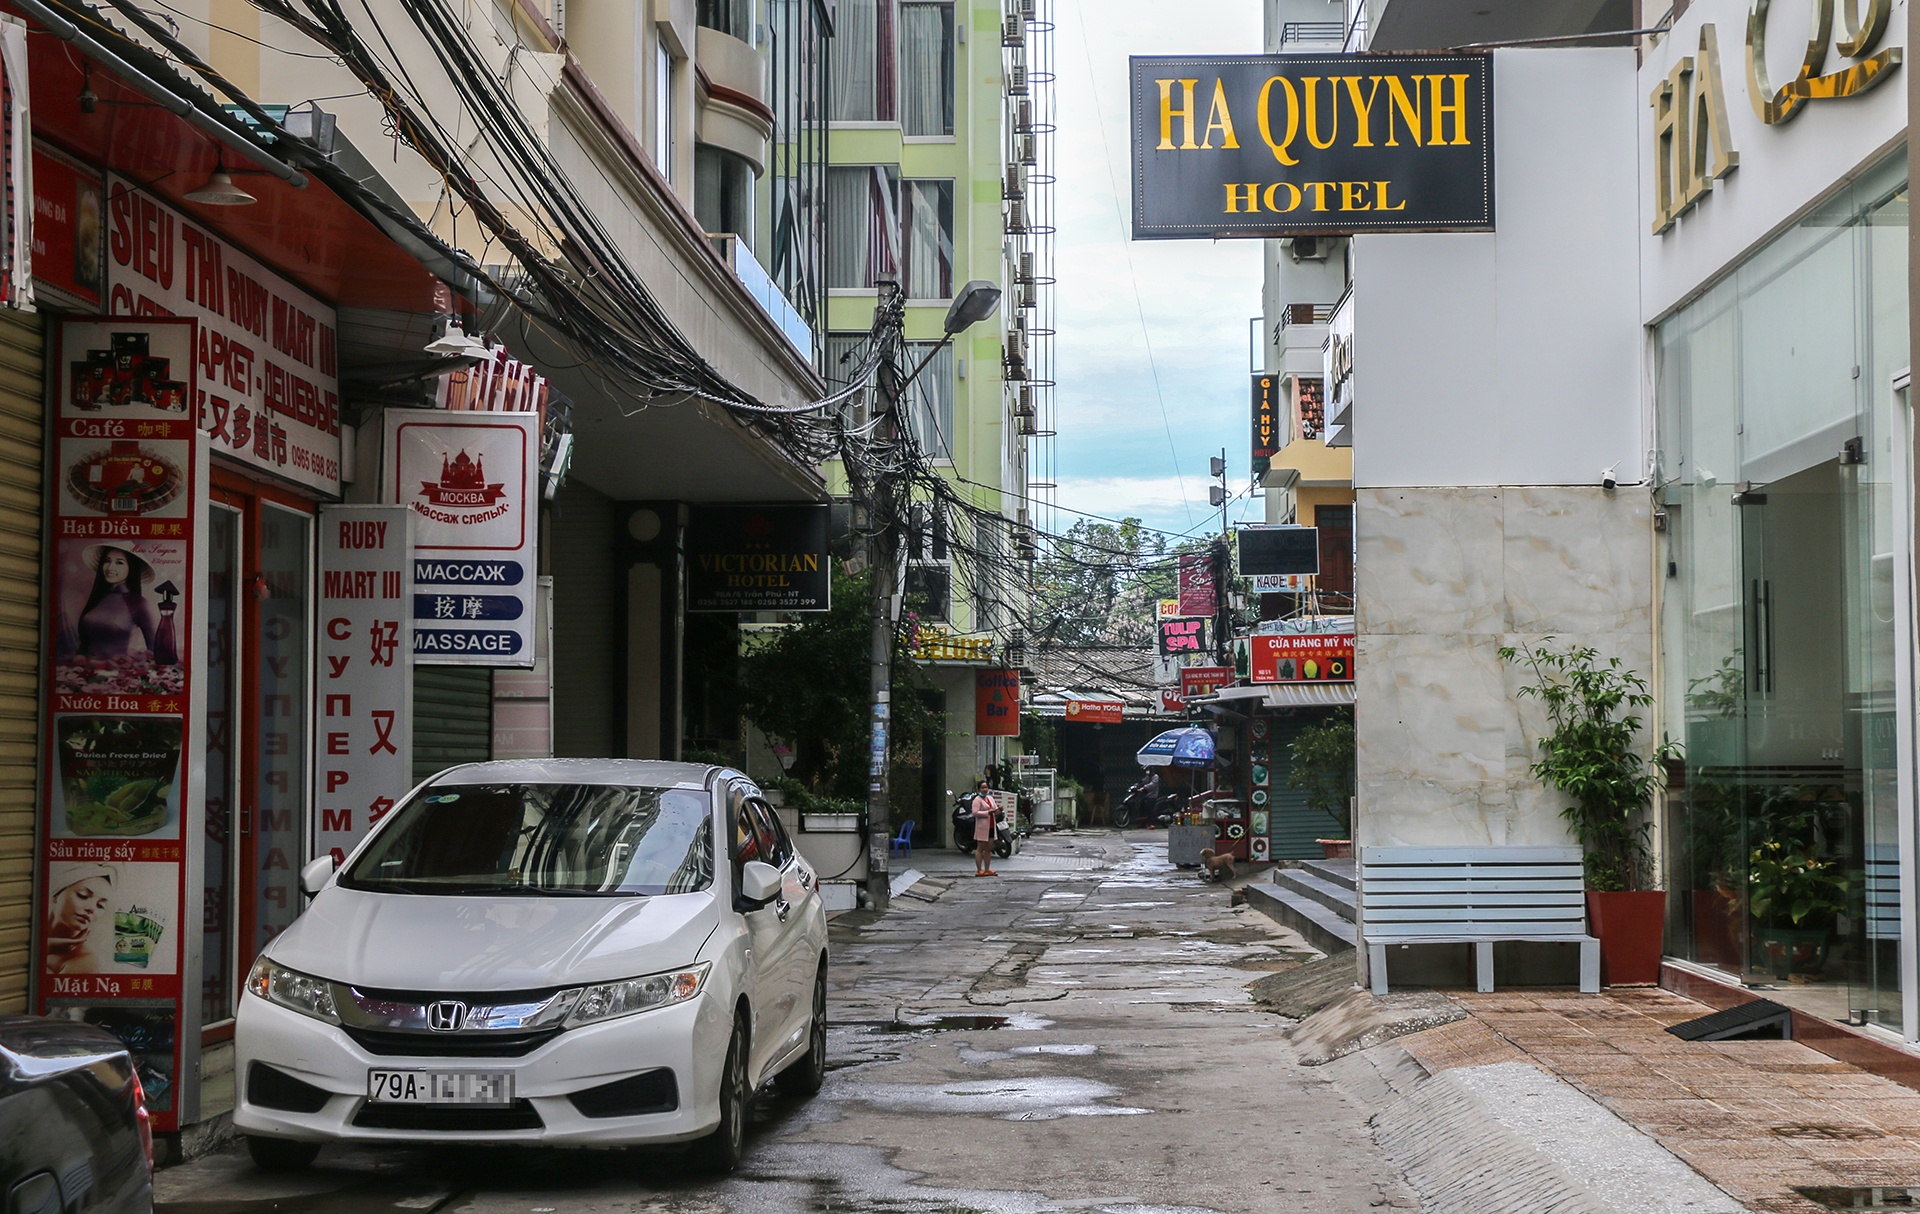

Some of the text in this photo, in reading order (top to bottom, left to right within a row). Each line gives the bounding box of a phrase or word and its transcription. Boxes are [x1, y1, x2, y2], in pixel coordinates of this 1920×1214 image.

[1156, 73, 1471, 167] HA QUYNH
[1652, 23, 1739, 236] HA
[1223, 180, 1406, 214] HOTEL
[227, 265, 269, 343] RUBY
[272, 294, 316, 369] MART
[320, 322, 336, 379] III
[264, 359, 339, 438] ДЕШЕВЫЕ
[1259, 378, 1272, 411] GIA
[70, 418, 171, 438] Café 咖啡
[1259, 414, 1271, 446] HUY
[292, 444, 337, 482] 0965 698 825
[440, 491, 486, 503] МОСКВА
[462, 503, 508, 525] слепых
[62, 520, 94, 538] Hạt
[100, 518, 141, 535] Điều
[339, 520, 387, 550] RUBY
[416, 564, 506, 582] МАССАЖ
[698, 553, 819, 573] VICTORIAN
[324, 570, 377, 599] MART
[382, 570, 400, 599] III
[727, 574, 791, 587] HOTEL
[779, 598, 798, 606] 3527
[800, 598, 816, 606] 399
[787, 590, 799, 598] NT
[434, 596, 483, 619] 按摩
[1163, 621, 1201, 636] TULIP
[414, 634, 511, 651] MASSAGE
[916, 638, 993, 660] DELUXE
[1166, 635, 1200, 651] SPA
[1268, 636, 1290, 648] CỬA
[1293, 636, 1321, 648] HÀNG
[1324, 636, 1340, 648] MỸ
[977, 674, 1017, 687] Coffee
[59, 695, 180, 713] Nước Hoa 香水
[987, 703, 1008, 716] Bar
[1103, 704, 1121, 712] YOGA
[75, 751, 167, 759] Durian Freeze Dried
[49, 839, 73, 858] Sầu
[77, 842, 111, 861] riêng
[114, 839, 136, 862] sấy
[53, 977, 154, 996] Mặt Nạ 面膜
